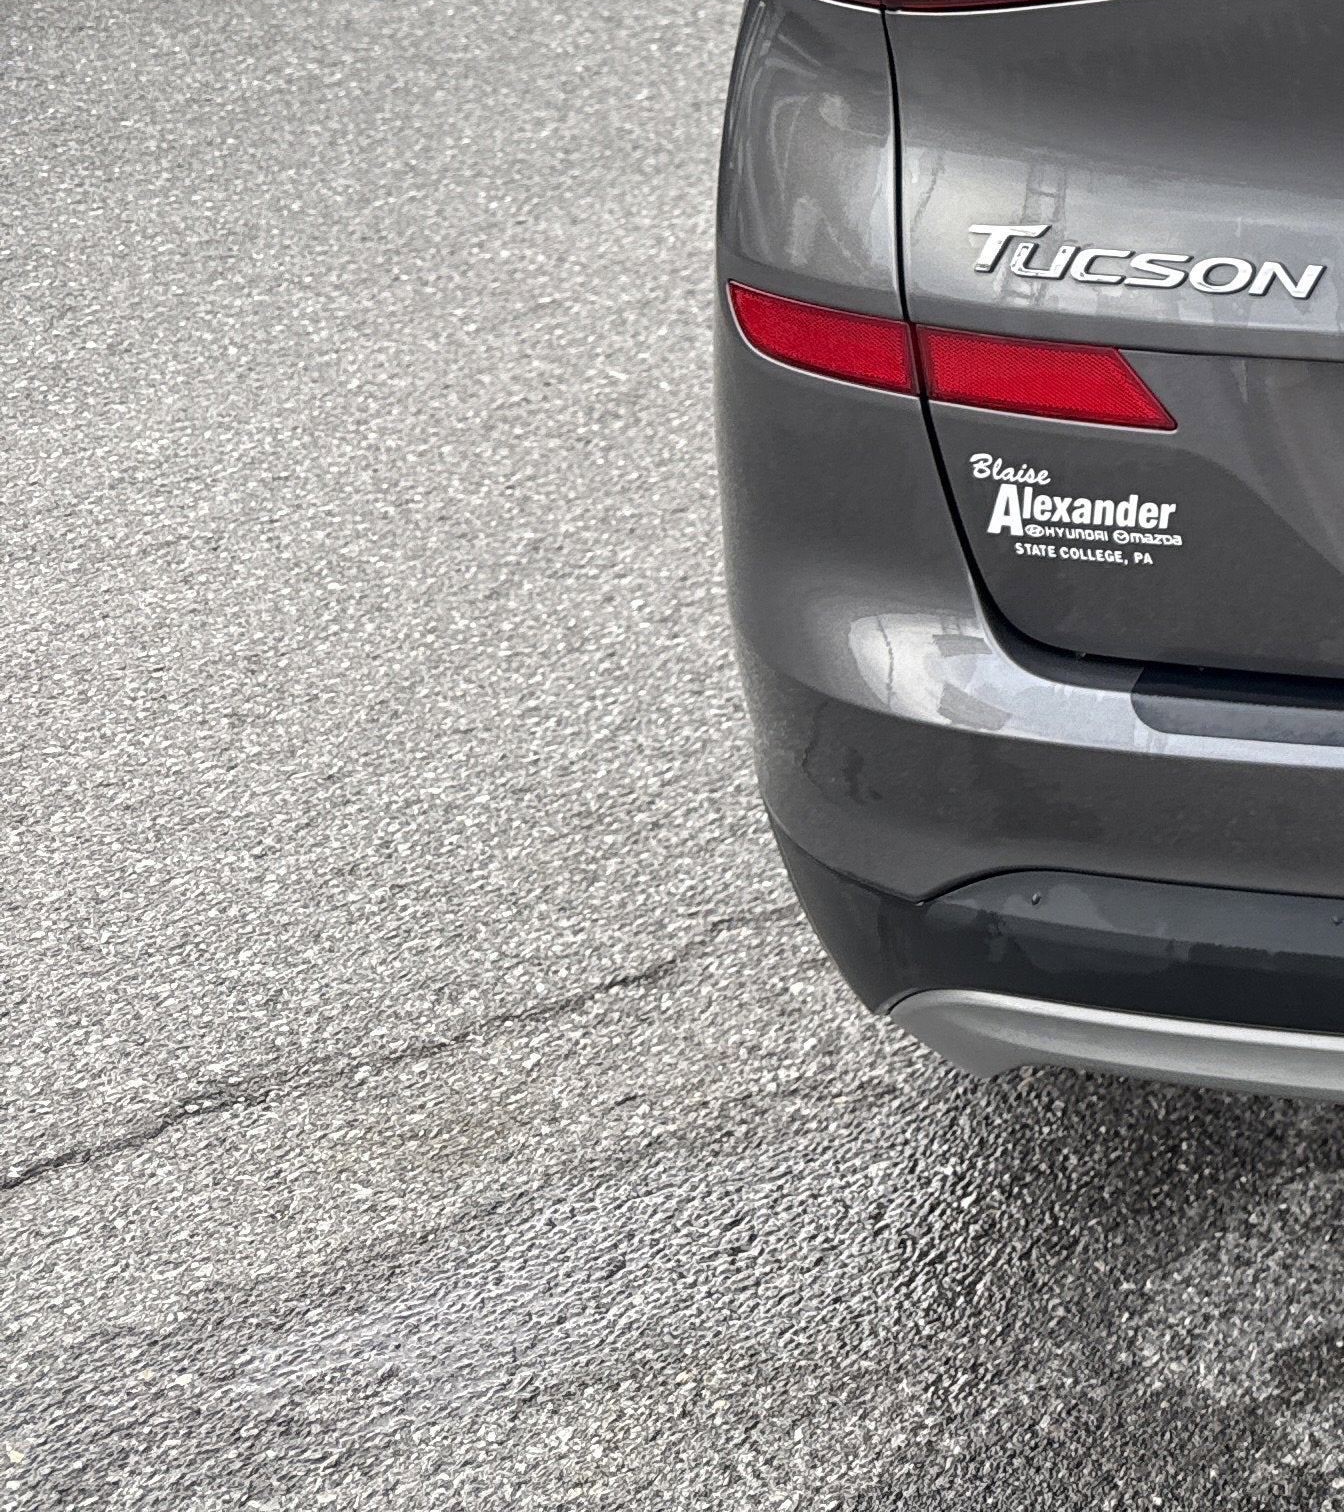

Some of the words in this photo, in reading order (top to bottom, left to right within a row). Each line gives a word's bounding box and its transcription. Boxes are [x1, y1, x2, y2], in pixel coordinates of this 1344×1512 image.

[968, 224, 1327, 299] TUCSON
[969, 453, 1051, 485] Blaise
[987, 483, 1177, 536] Alexander
[1045, 527, 1109, 542] HYUNDAI
[1015, 542, 1056, 558] STATE
[1060, 546, 1128, 565] COLLEGE,
[1134, 552, 1153, 565] PA
